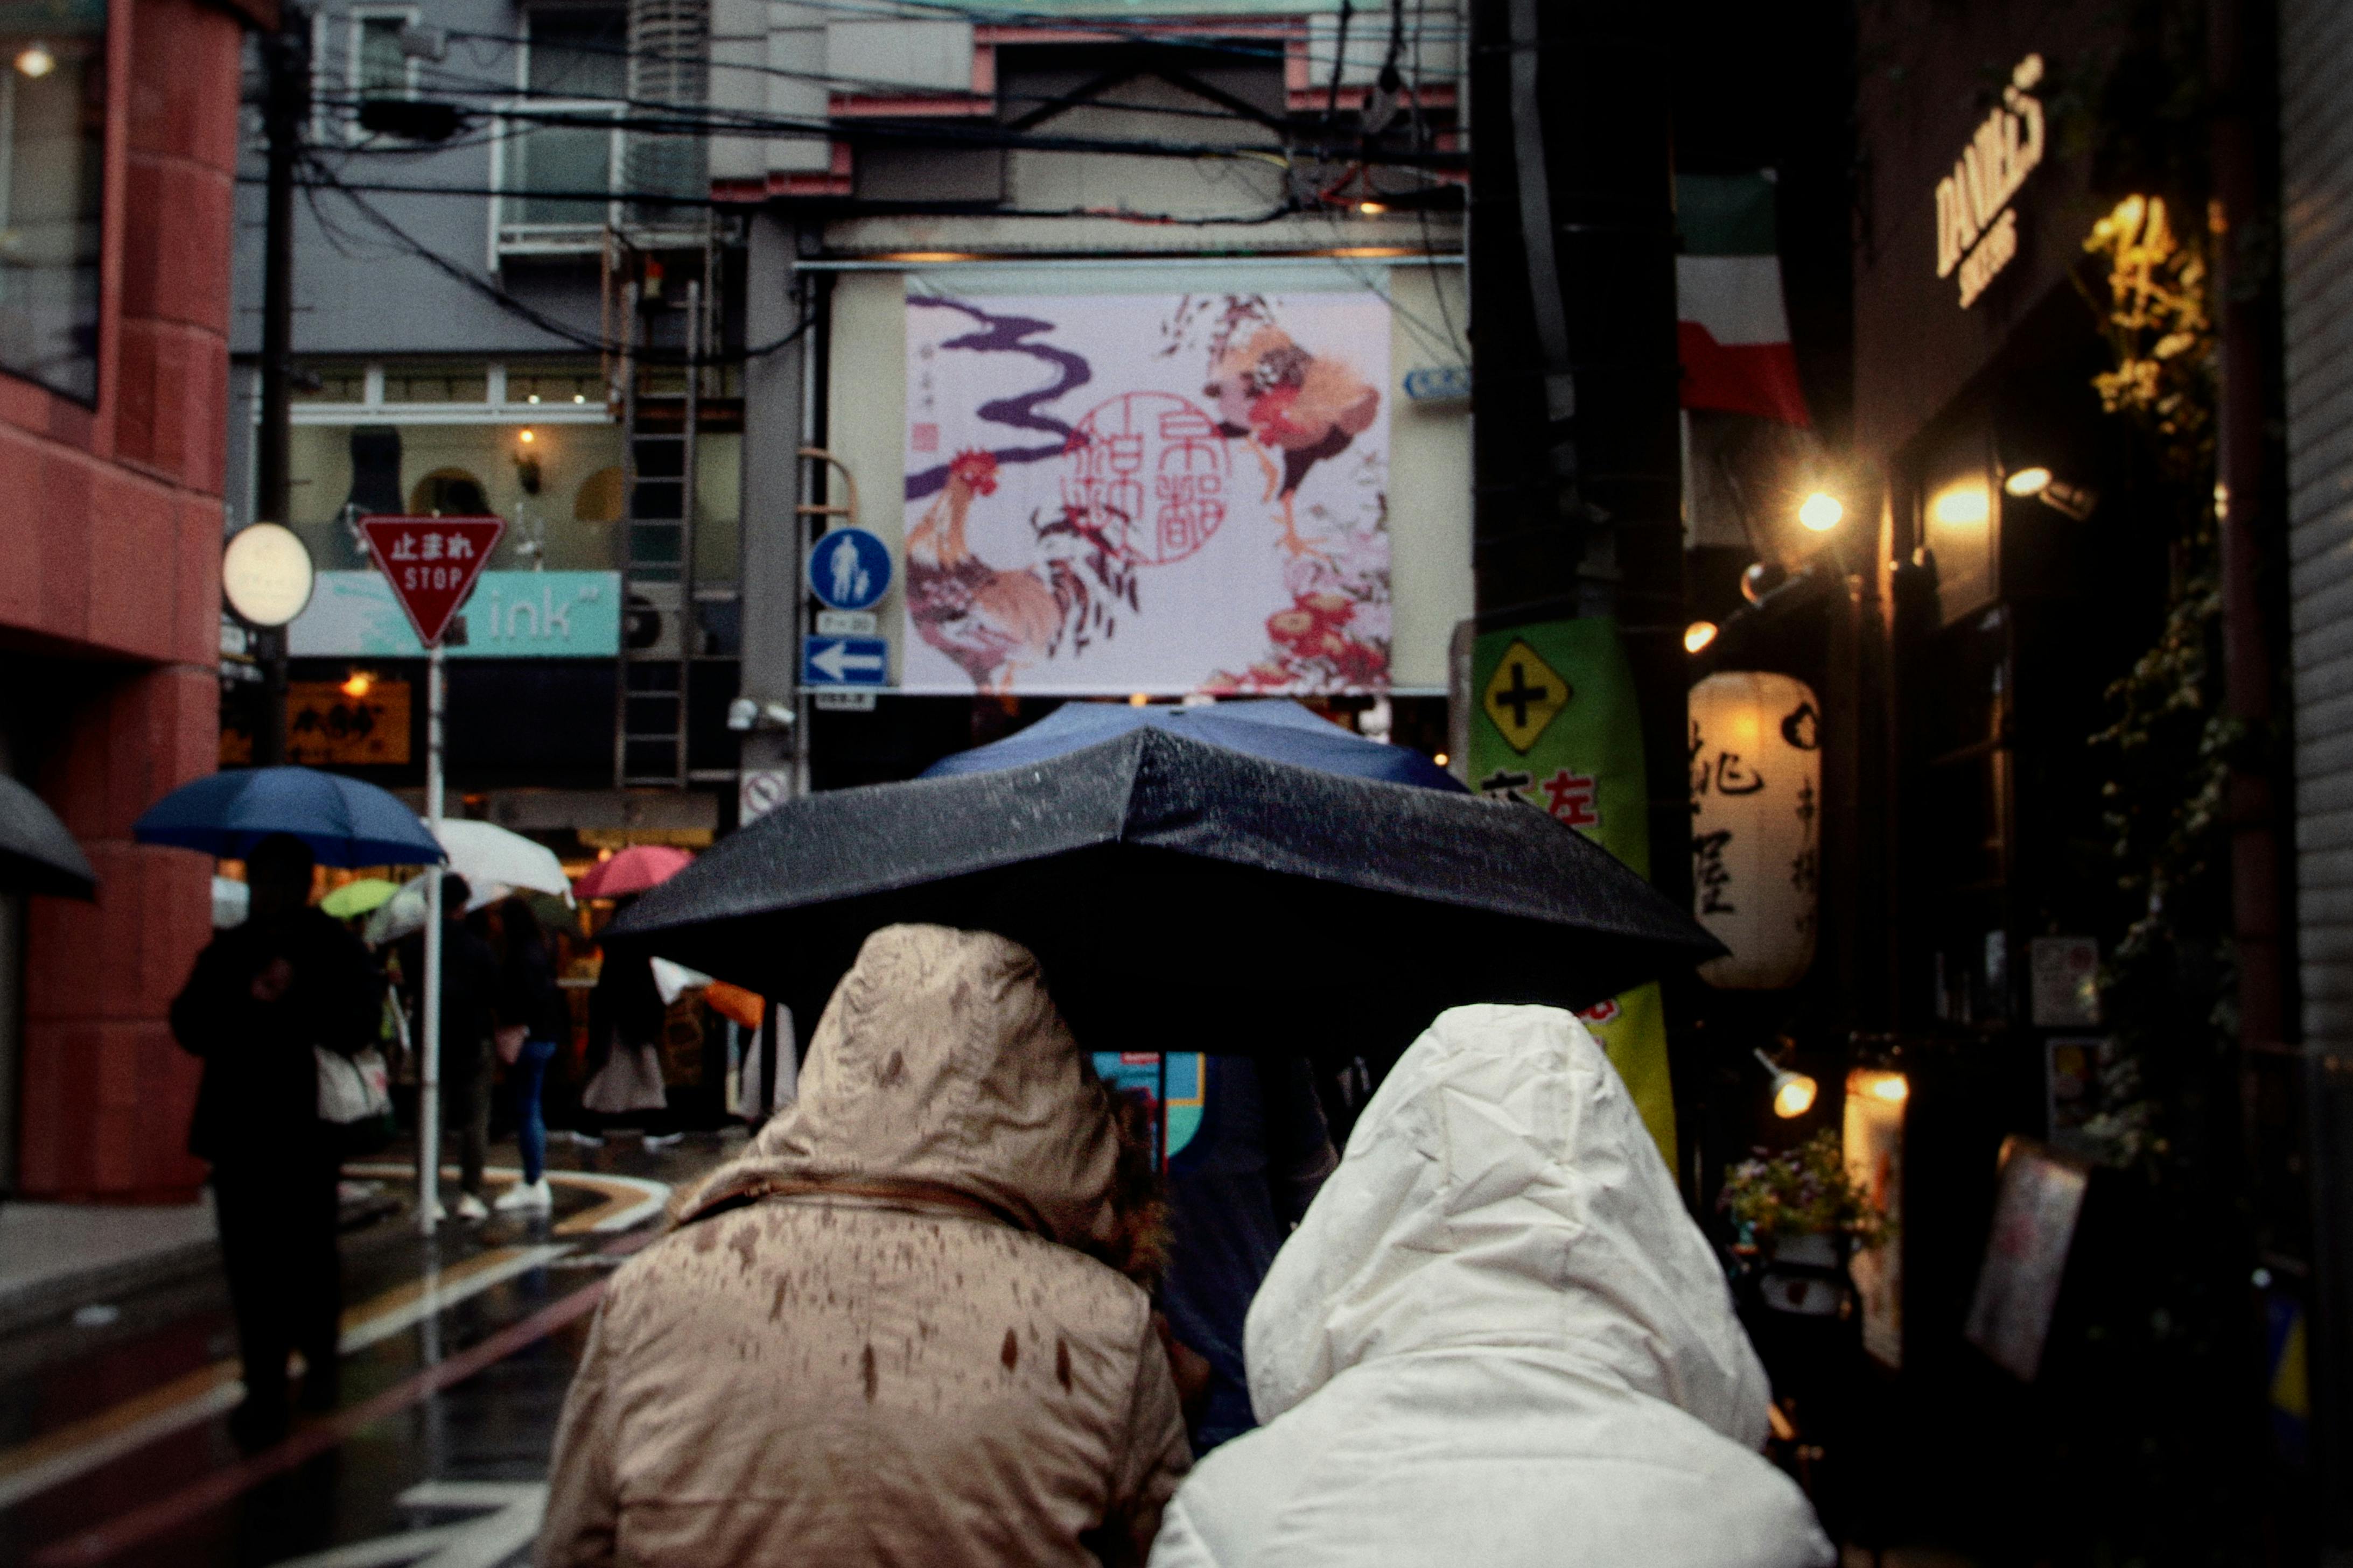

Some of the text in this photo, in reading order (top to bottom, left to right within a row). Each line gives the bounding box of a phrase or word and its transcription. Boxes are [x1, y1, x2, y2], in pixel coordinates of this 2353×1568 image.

[390, 531, 474, 561] 止まれ
[404, 566, 463, 590] STOP
